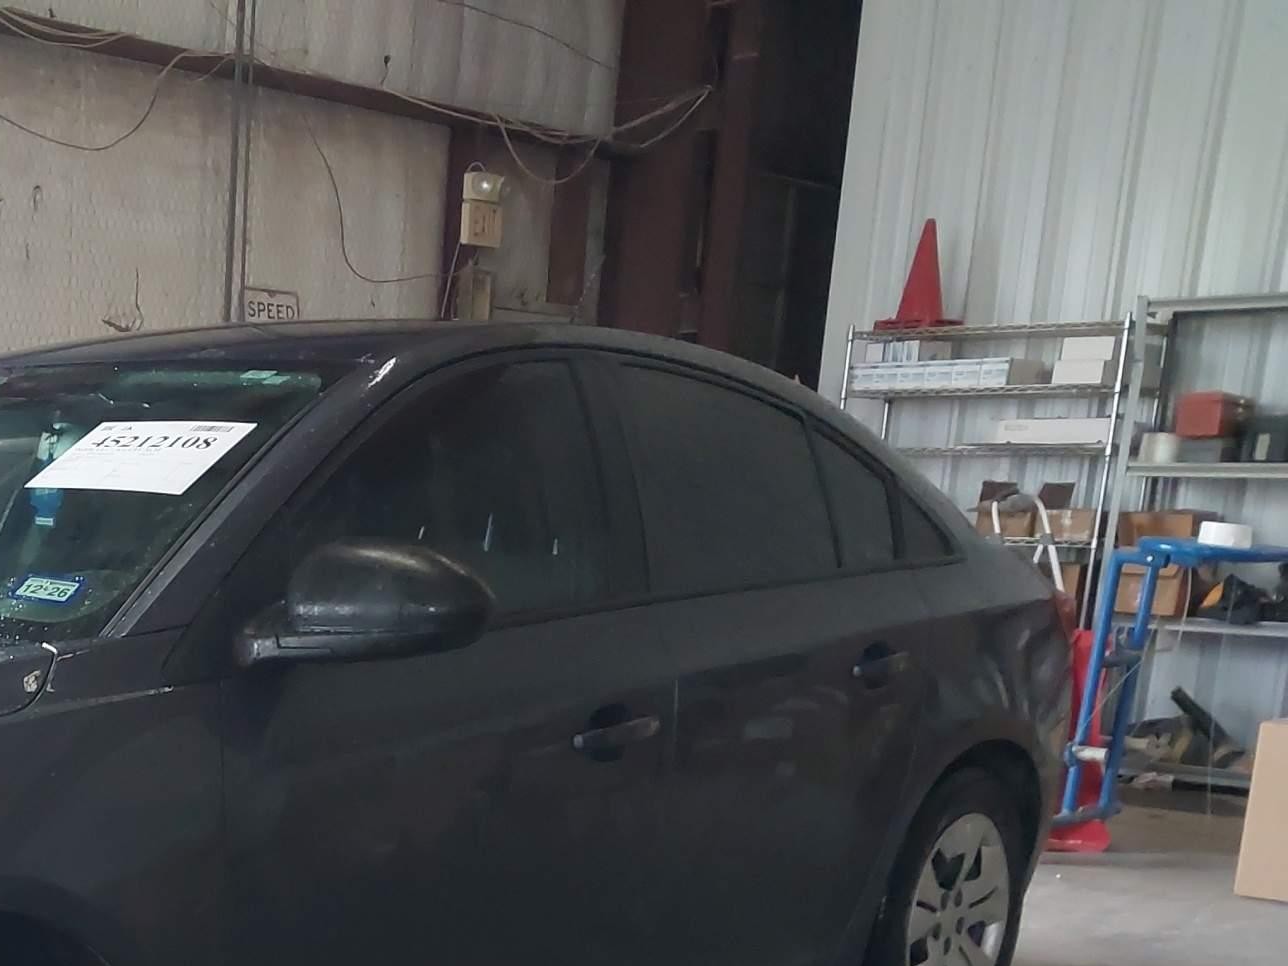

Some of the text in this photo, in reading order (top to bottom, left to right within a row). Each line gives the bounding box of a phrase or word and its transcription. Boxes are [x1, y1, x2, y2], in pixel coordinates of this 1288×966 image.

[247, 300, 295, 320] SPEED
[91, 434, 218, 450] 45212108
[22, 583, 70, 598] 12 26
